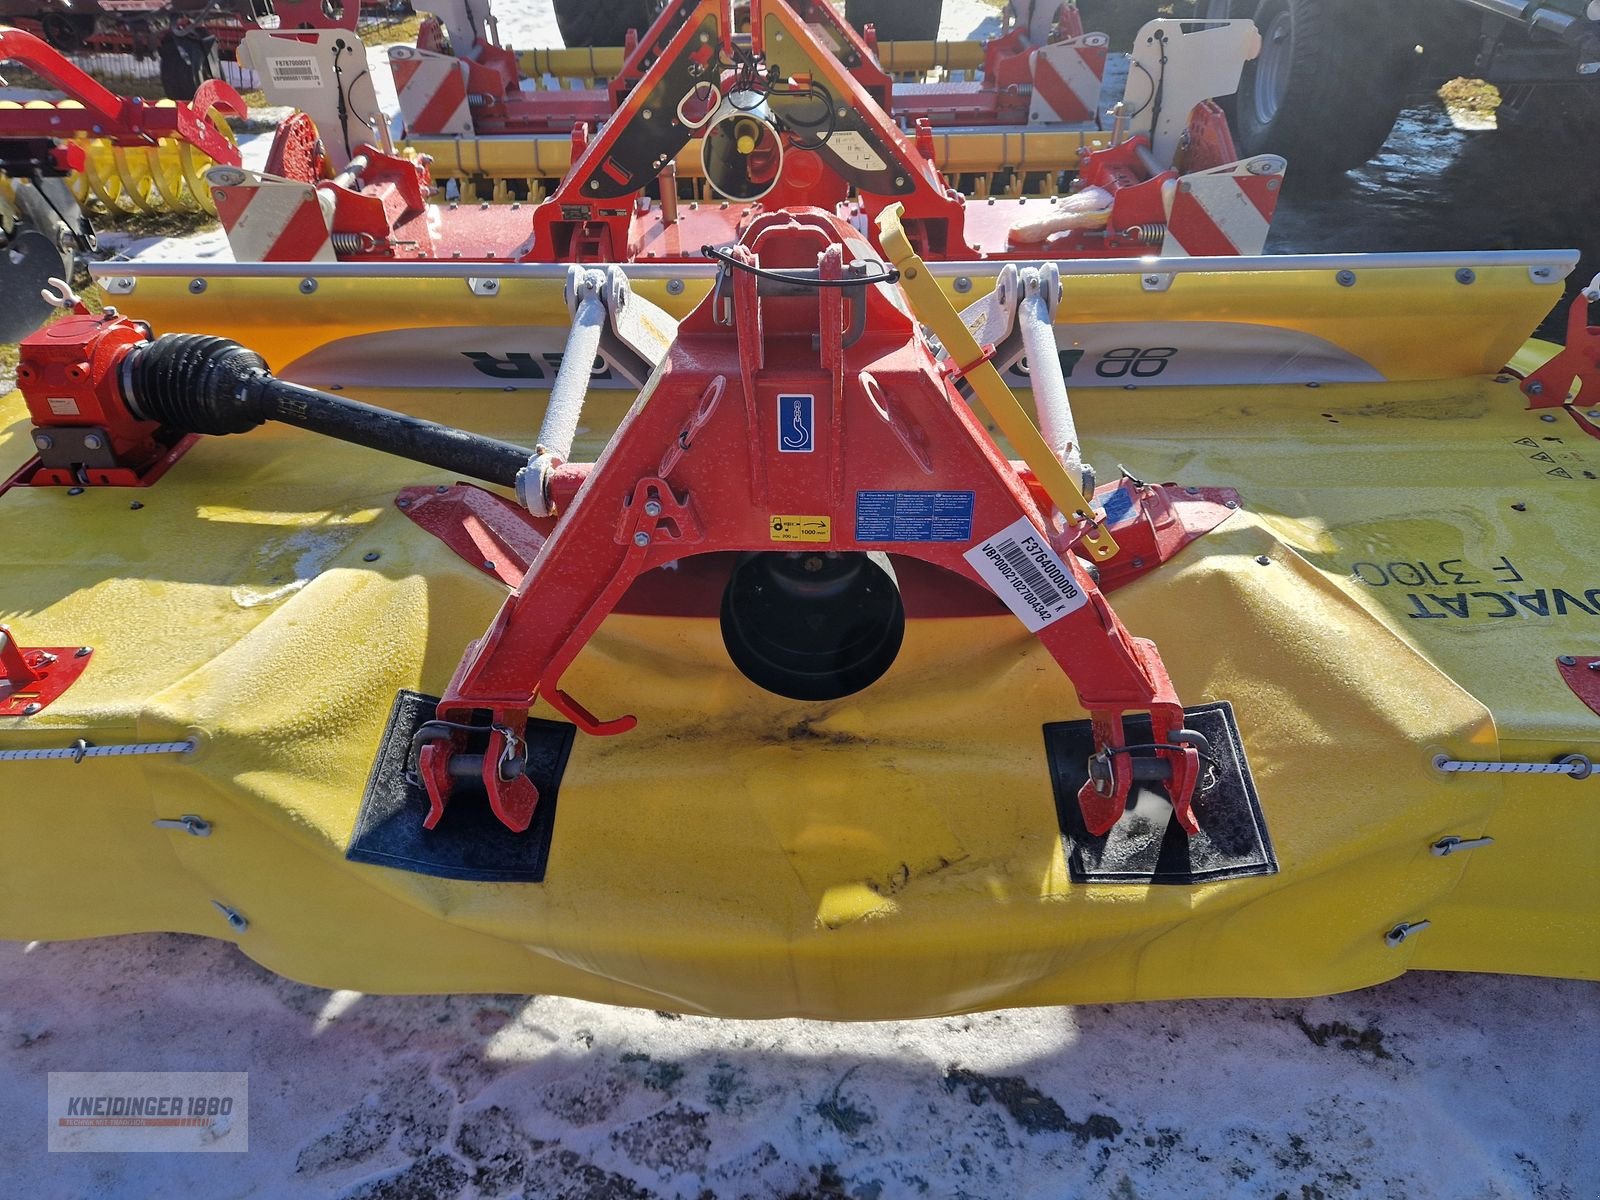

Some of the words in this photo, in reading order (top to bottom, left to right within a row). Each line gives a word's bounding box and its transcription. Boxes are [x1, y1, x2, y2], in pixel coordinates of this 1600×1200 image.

[981, 543, 1052, 621] VBP00021027004342
[1020, 536, 1078, 600] F3764000009
[1352, 558, 1481, 587] 3100
[1492, 556, 1524, 583] F
[1054, 604, 1066, 613] K
